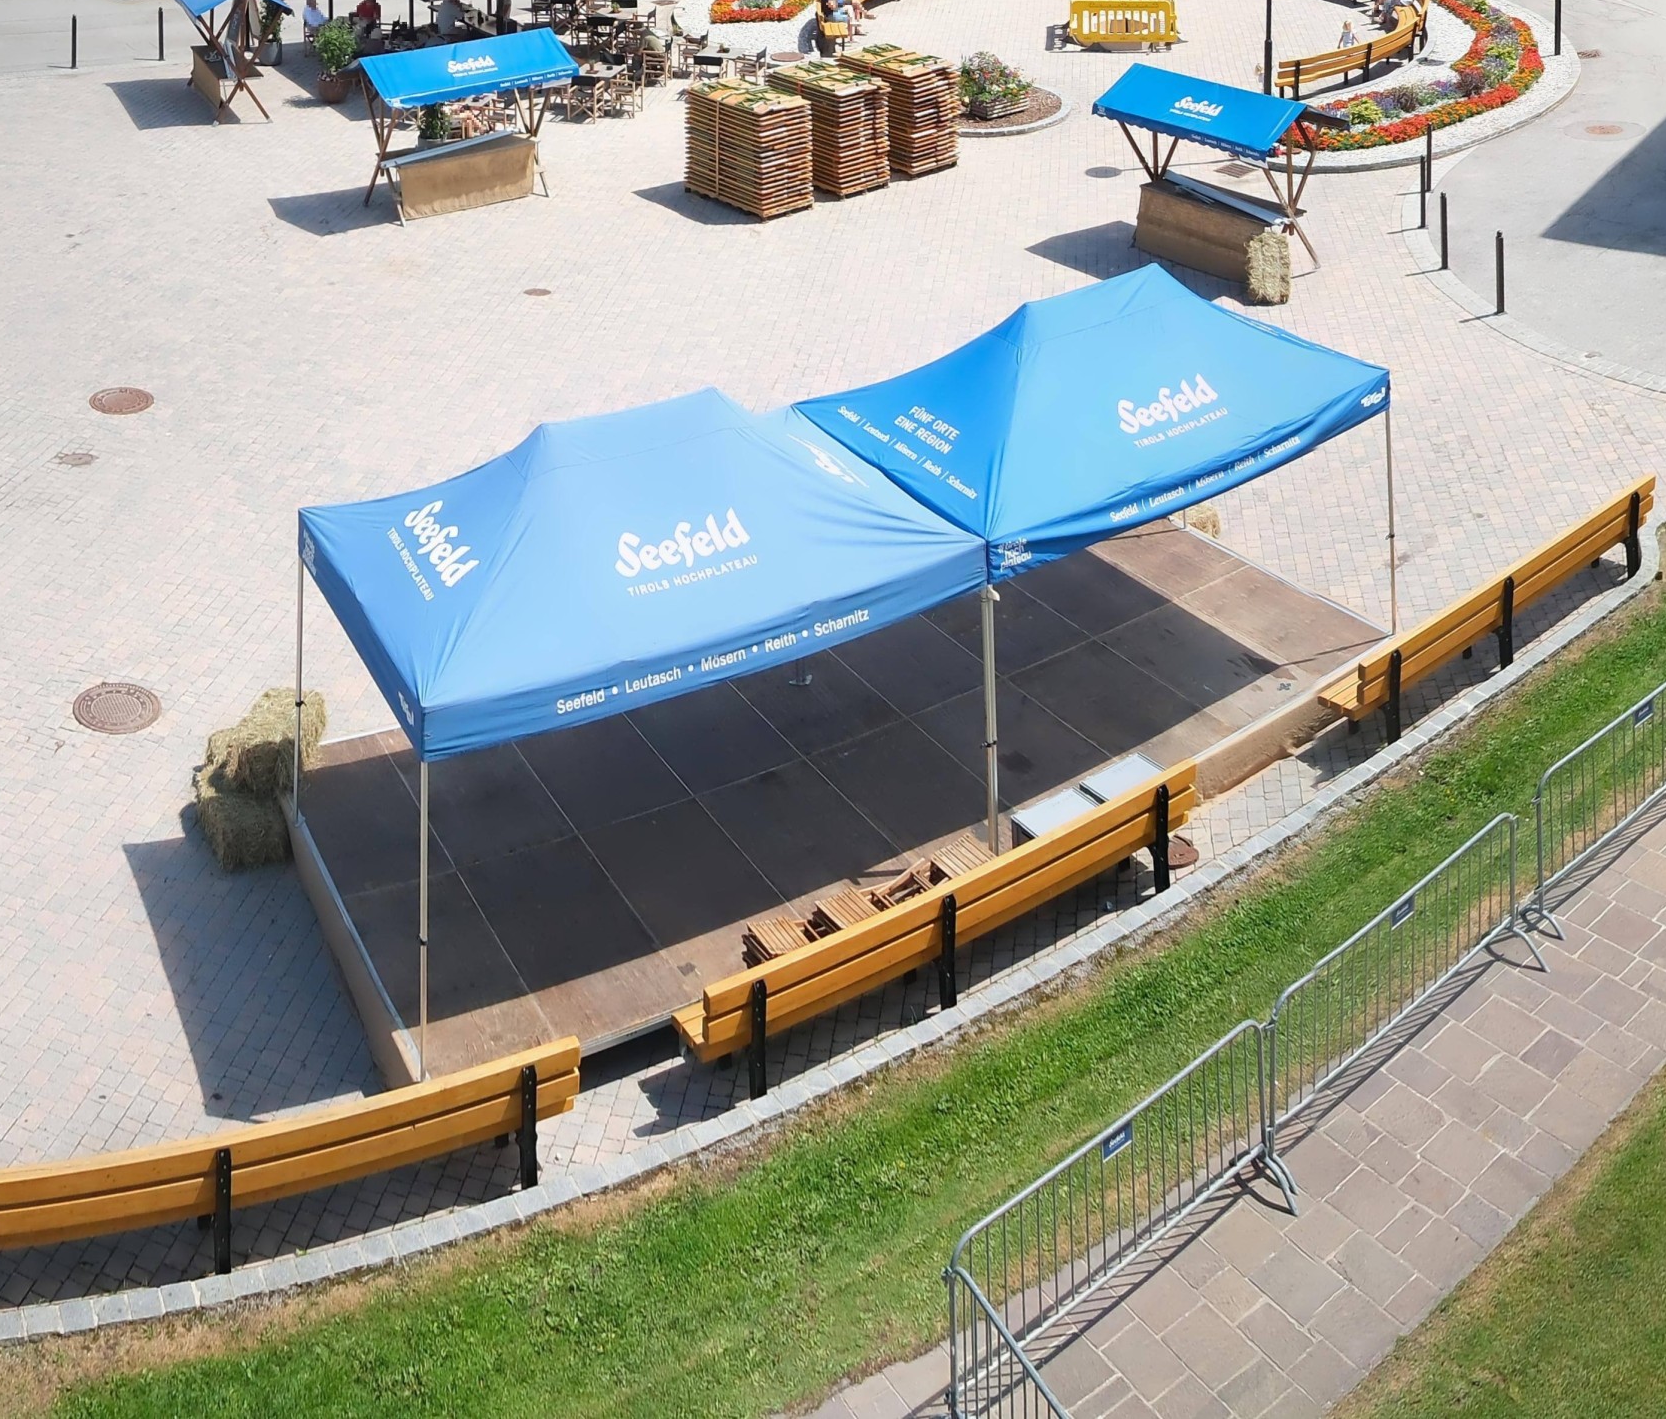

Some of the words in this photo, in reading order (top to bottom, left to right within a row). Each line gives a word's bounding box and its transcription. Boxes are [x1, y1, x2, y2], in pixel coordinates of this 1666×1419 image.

[447, 55, 496, 73] Seefeld
[1173, 96, 1225, 117] Seefeld
[908, 405, 936, 429] FÜNF
[934, 419, 961, 441] ORTE
[1117, 372, 1219, 435] Seefeld
[1133, 430, 1166, 450] TIROLS
[1166, 406, 1229, 438] HOCHPLATEAU
[894, 415, 916, 434] EINE
[914, 427, 953, 455] REGION
[1109, 502, 1139, 524] Seefeld
[1149, 485, 1185, 509] Leutasch
[1234, 455, 1256, 472] Reith
[1263, 436, 1302, 459] Scharnitz
[387, 526, 405, 552] TIROLS
[399, 547, 435, 601] HOCHPLATEAU
[403, 499, 480, 588] Seefeld
[614, 506, 751, 578] Seefeld
[626, 579, 671, 597] TIROLS
[672, 554, 759, 587] HOCHPLATEAU
[556, 690, 606, 714] Seefeld
[625, 667, 682, 694] Leutasch
[700, 649, 746, 672] Mösern
[764, 632, 797, 653] Reith
[813, 608, 870, 637] Scharnitz
